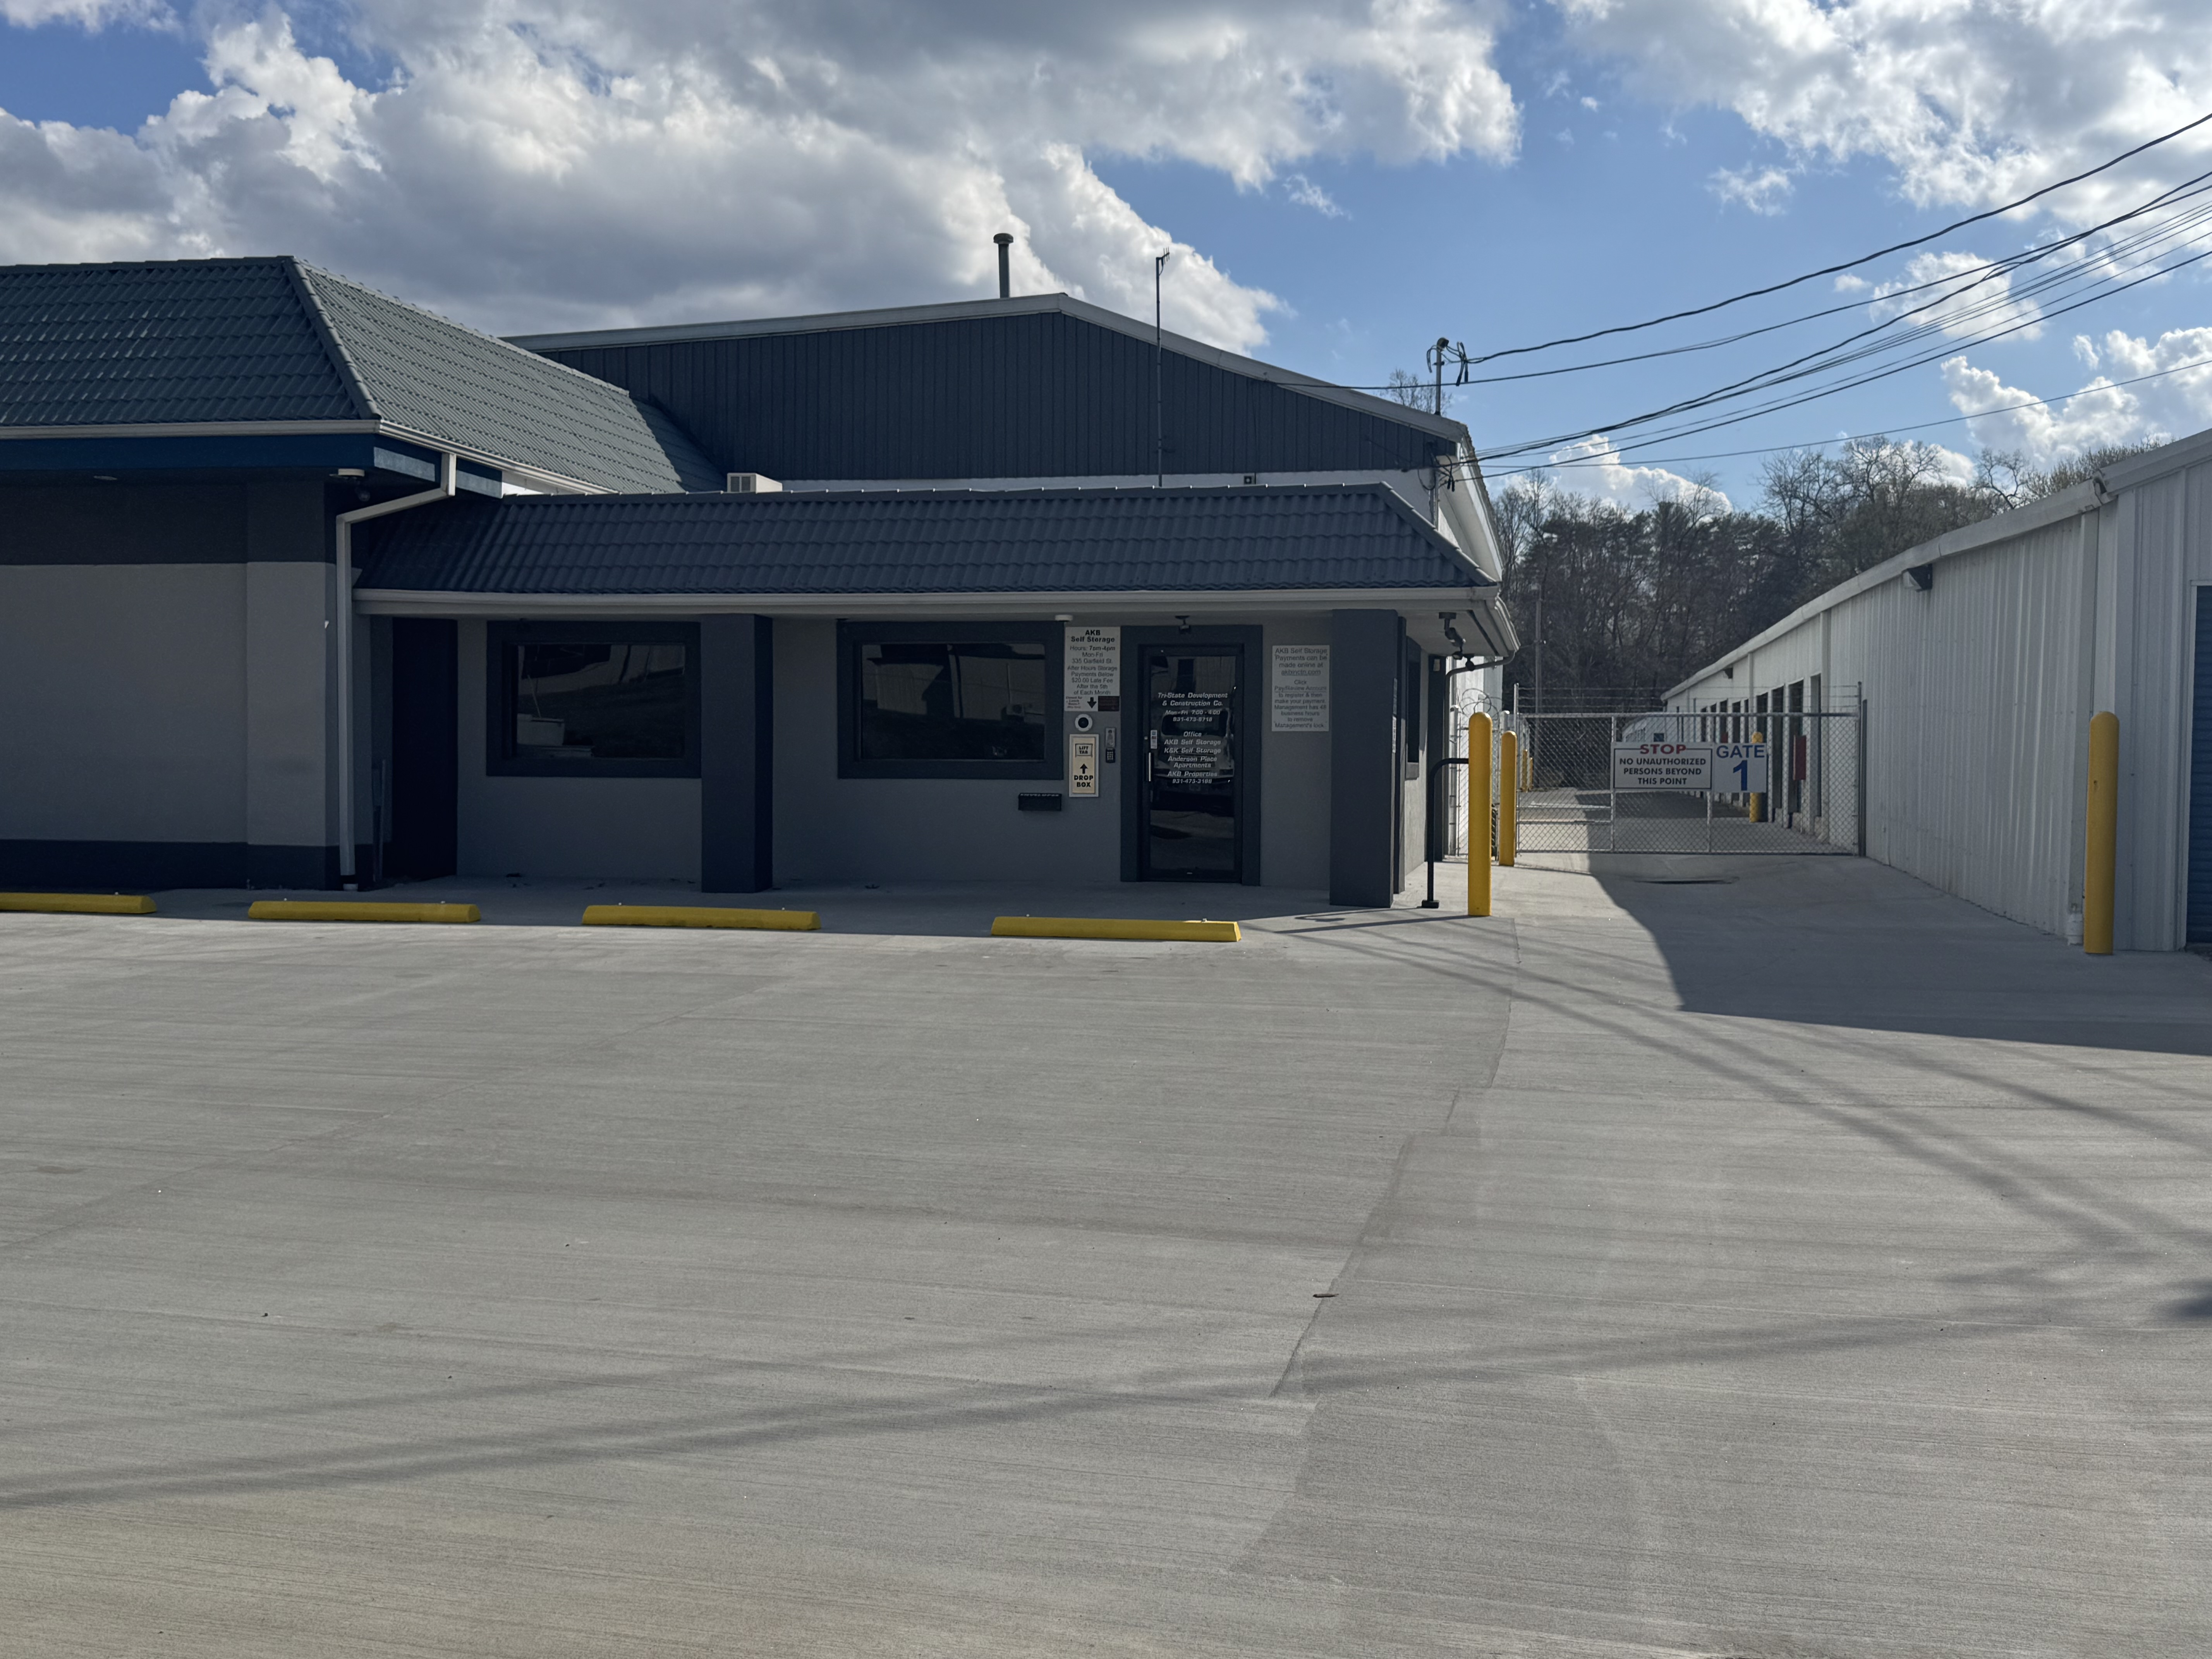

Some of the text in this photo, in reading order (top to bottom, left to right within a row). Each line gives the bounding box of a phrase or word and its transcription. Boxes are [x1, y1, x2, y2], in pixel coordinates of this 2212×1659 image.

[1640, 744, 1686, 754] STOP
[1716, 745, 1765, 758] GATE
[1733, 759, 1748, 791] 1
